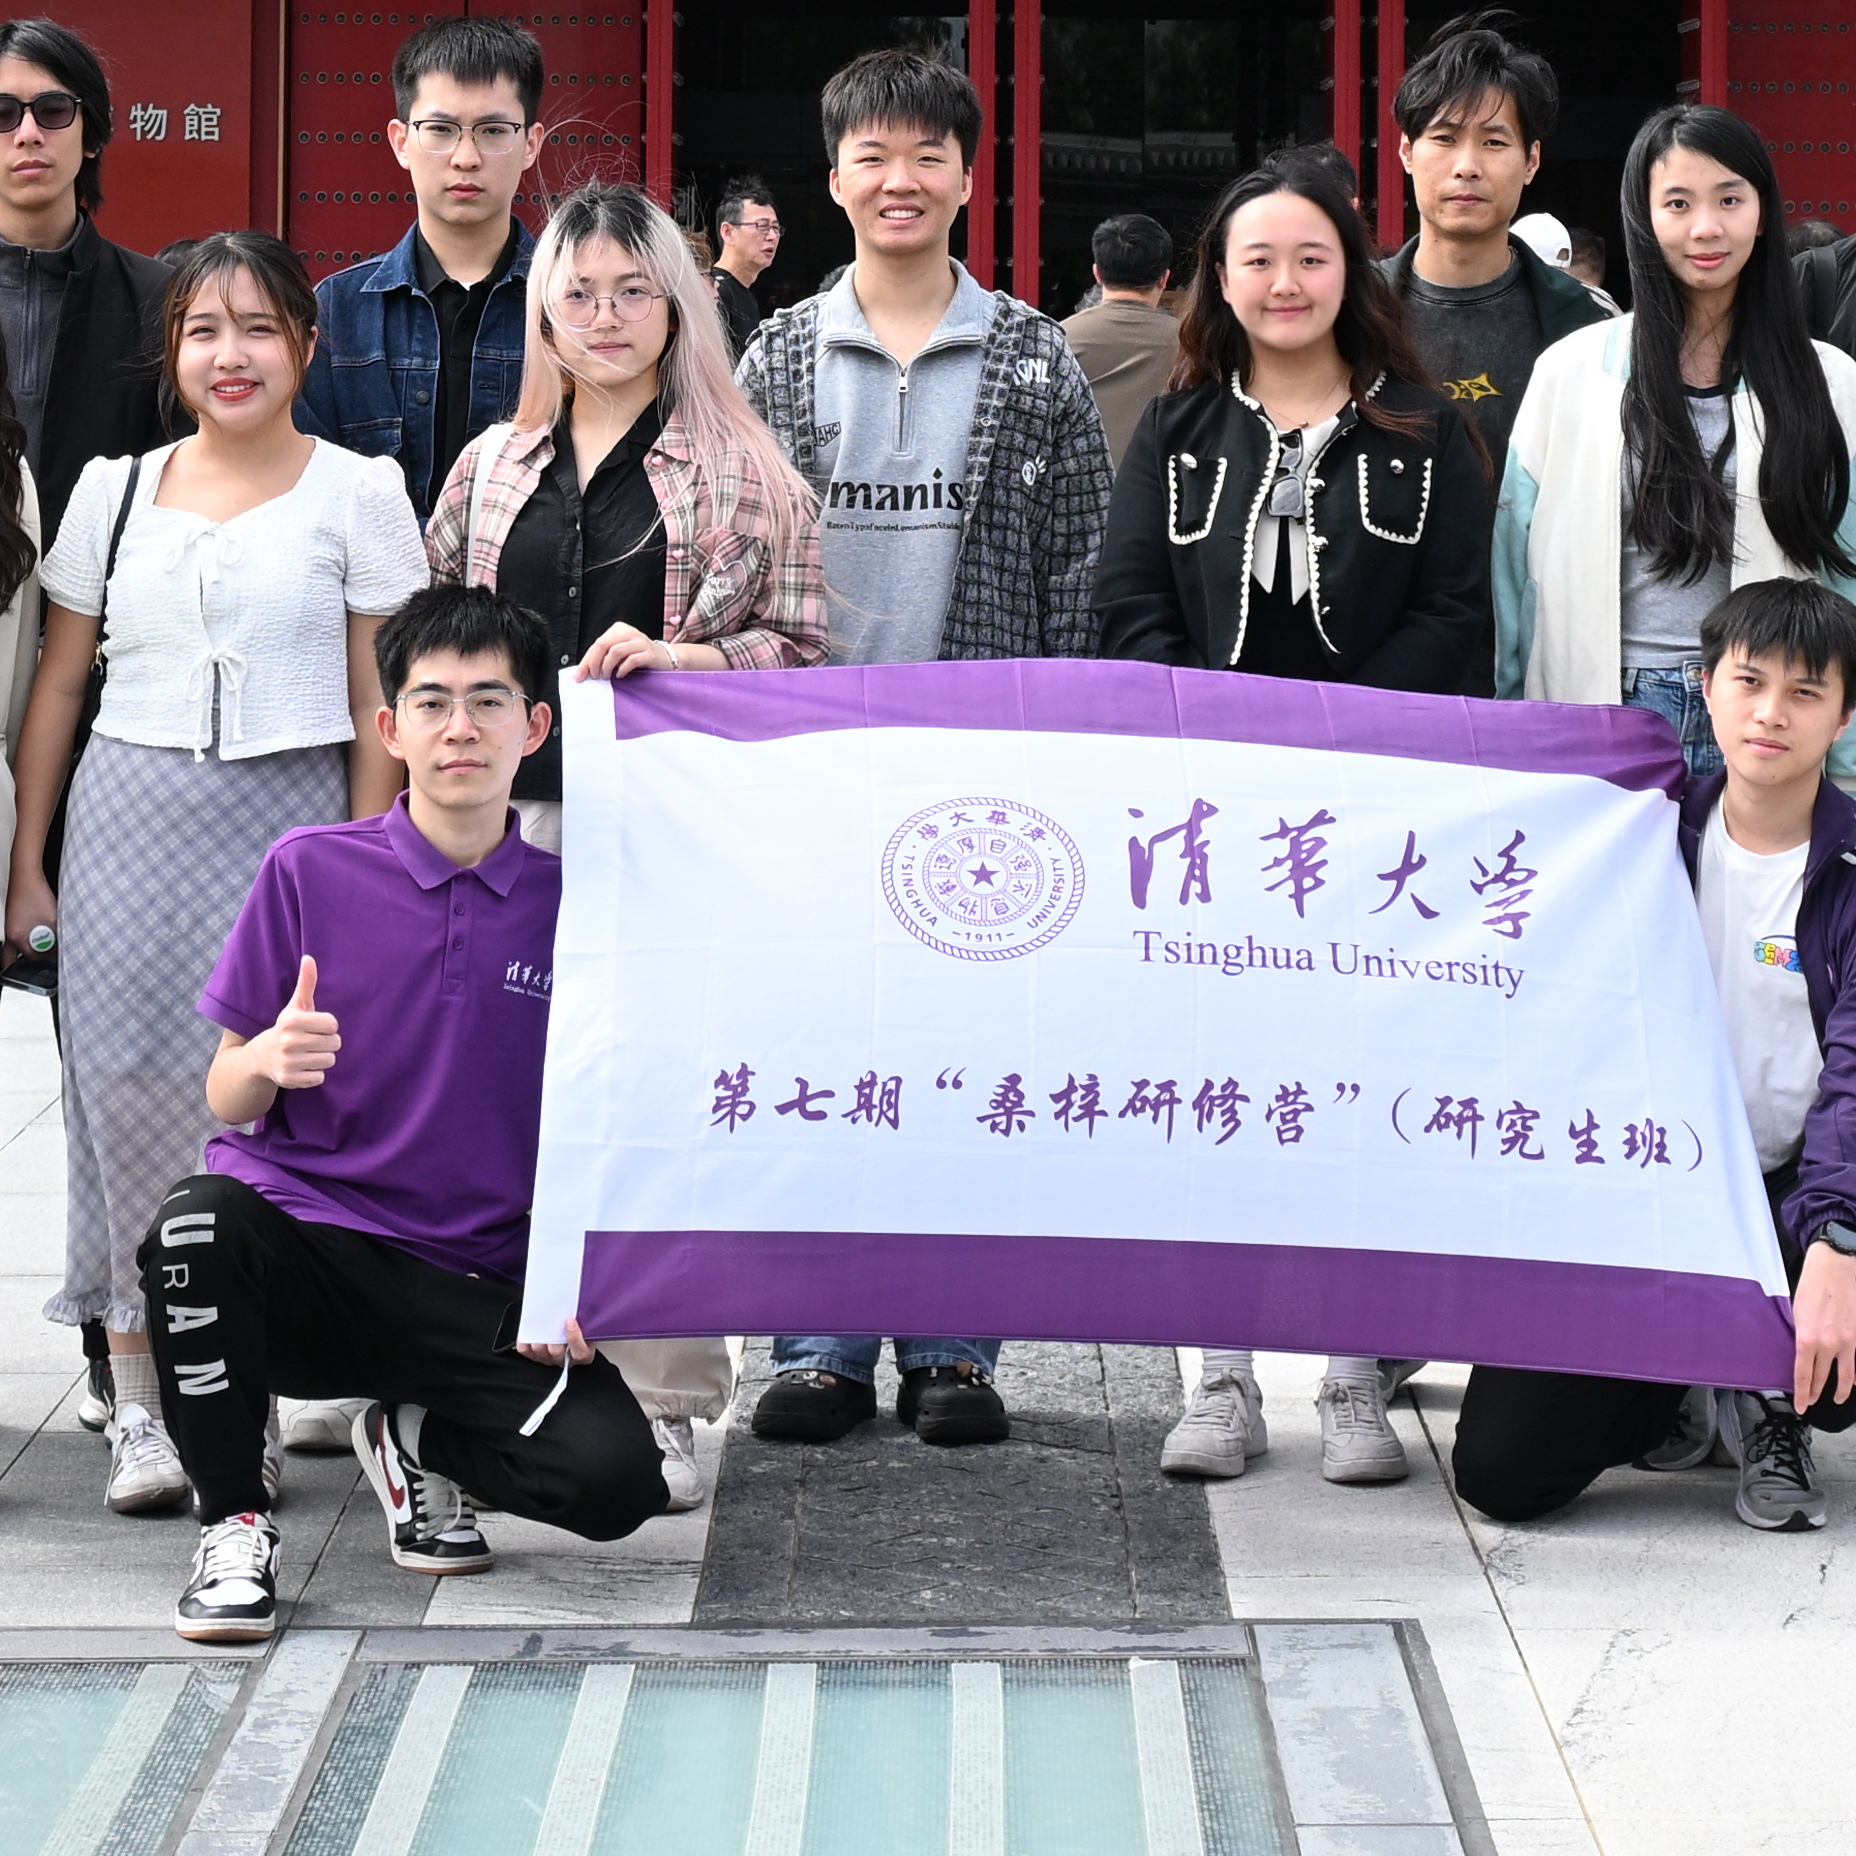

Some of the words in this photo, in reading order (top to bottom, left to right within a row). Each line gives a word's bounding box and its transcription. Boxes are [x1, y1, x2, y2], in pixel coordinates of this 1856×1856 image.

[829, 467, 964, 511] manis
[901, 854, 938, 928] TSINGHUA
[1026, 856, 1066, 930] UNIVERSITY
[1132, 930, 1317, 977] Tsinghua
[1326, 941, 1526, 1000] University
